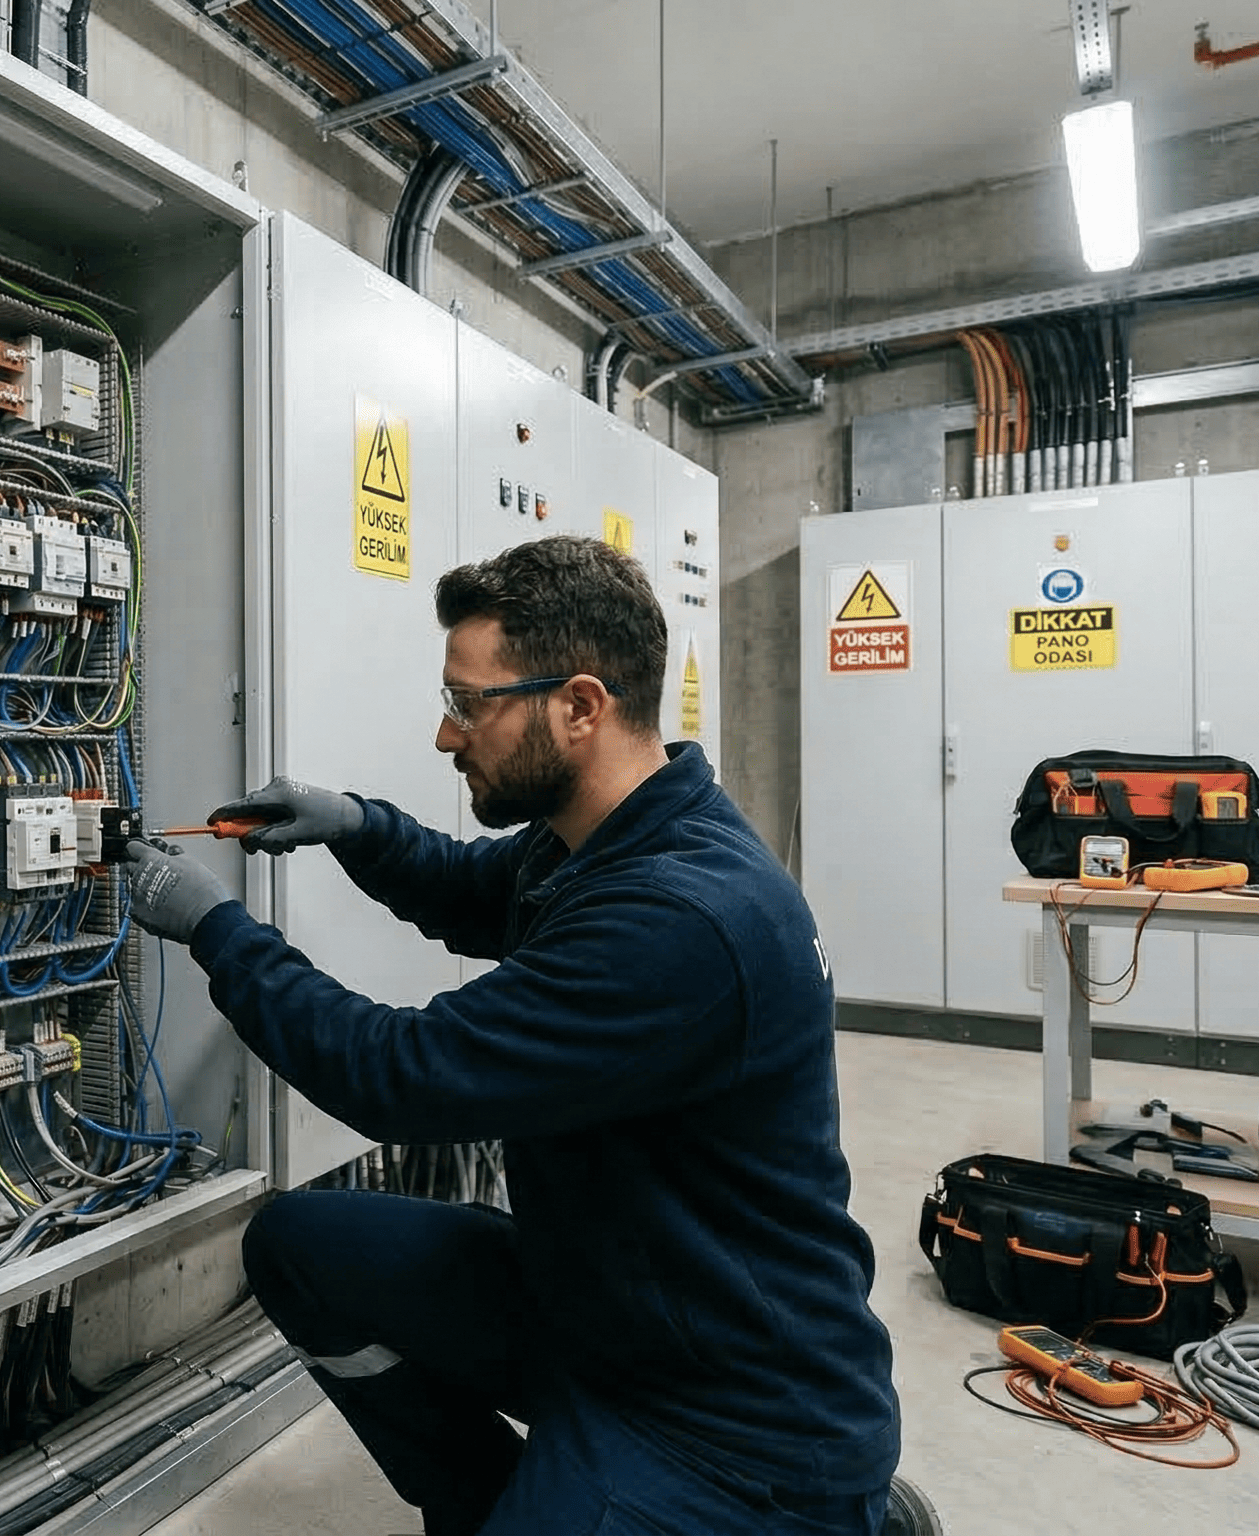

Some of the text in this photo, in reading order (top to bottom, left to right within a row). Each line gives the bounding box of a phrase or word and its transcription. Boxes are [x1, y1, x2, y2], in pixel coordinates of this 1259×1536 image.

[360, 501, 407, 535] YÜKSEK
[359, 536, 407, 564] GERİLİM
[1020, 610, 1107, 631] DİKKAT
[834, 630, 905, 647] YÜKSEK
[1037, 634, 1089, 649] PANO
[834, 647, 905, 666] GERİLİM
[1034, 649, 1093, 664] ODASI
